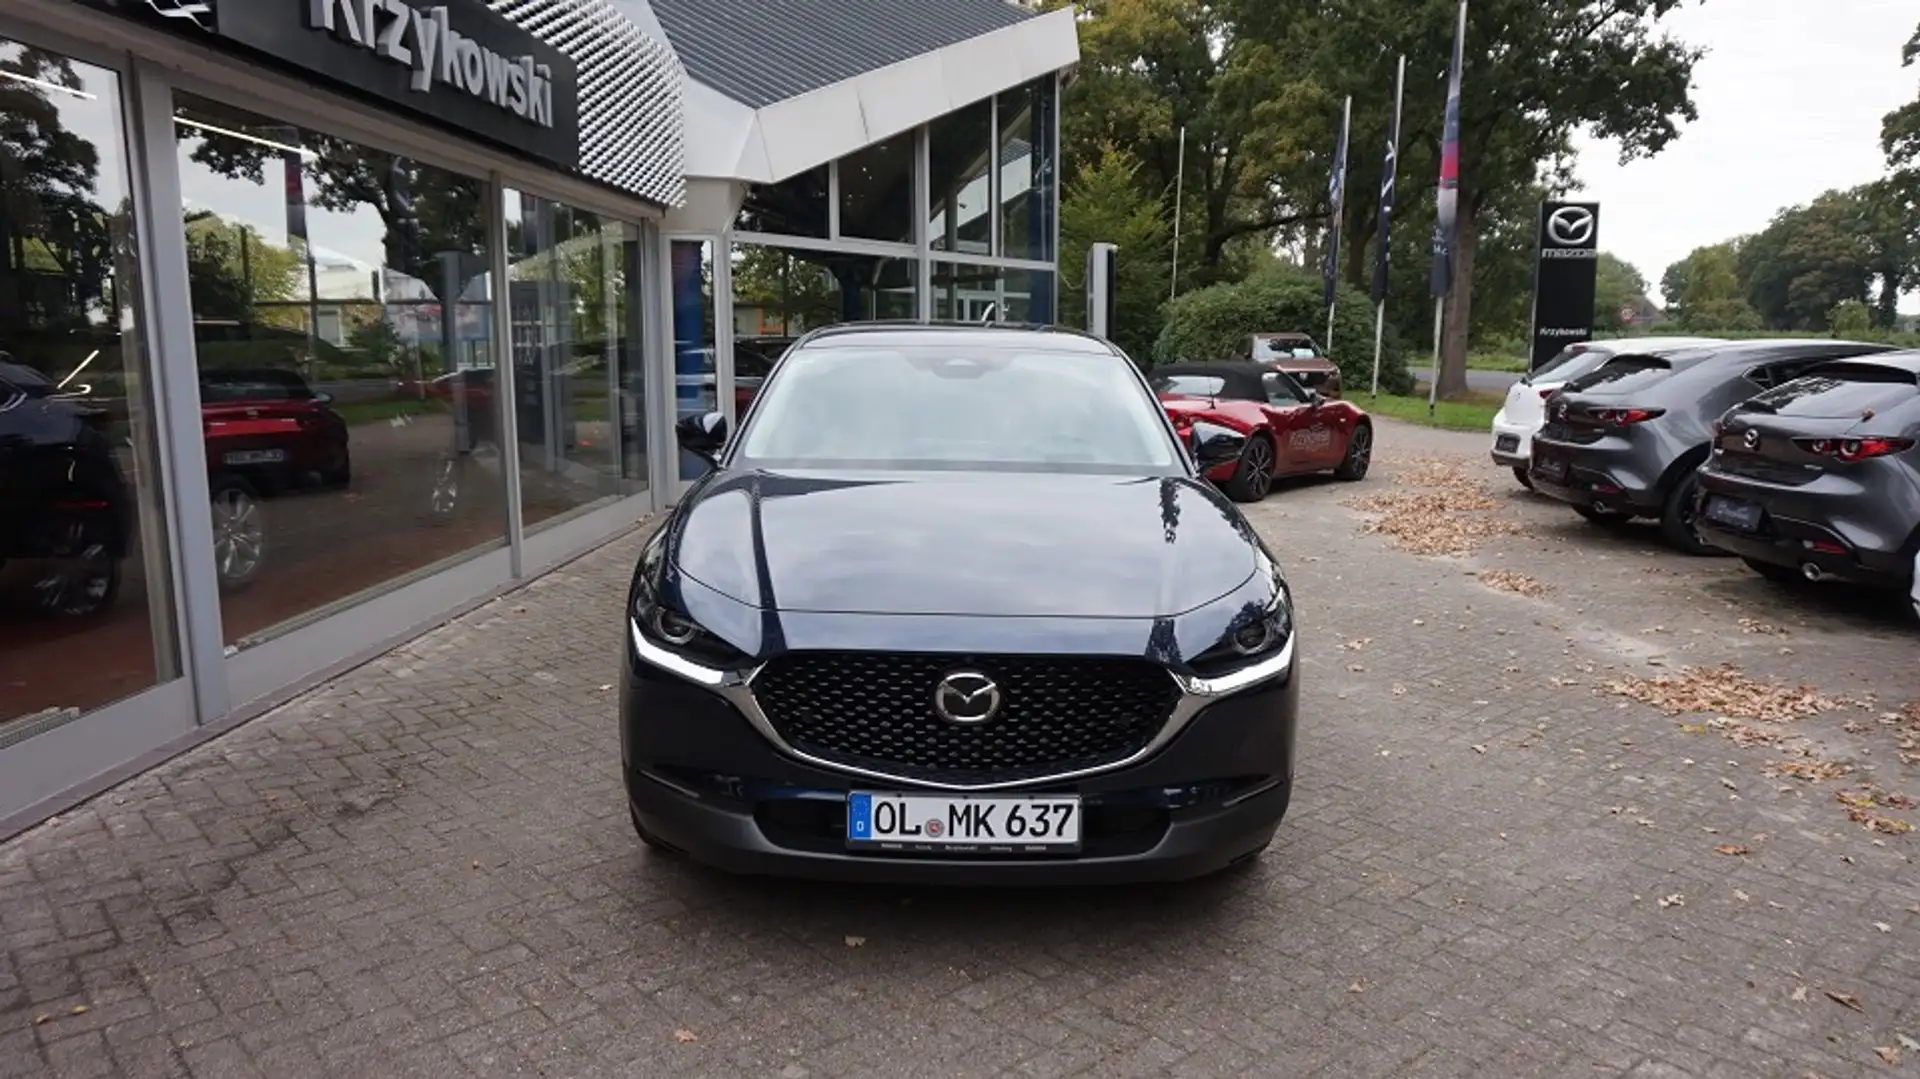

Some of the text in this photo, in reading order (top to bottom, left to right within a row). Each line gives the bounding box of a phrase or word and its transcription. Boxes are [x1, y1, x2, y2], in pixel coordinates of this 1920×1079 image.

[309, 0, 554, 128] Krzykowski
[874, 802, 922, 835] OL
[948, 804, 996, 838] MK
[1005, 804, 1075, 838] 637
